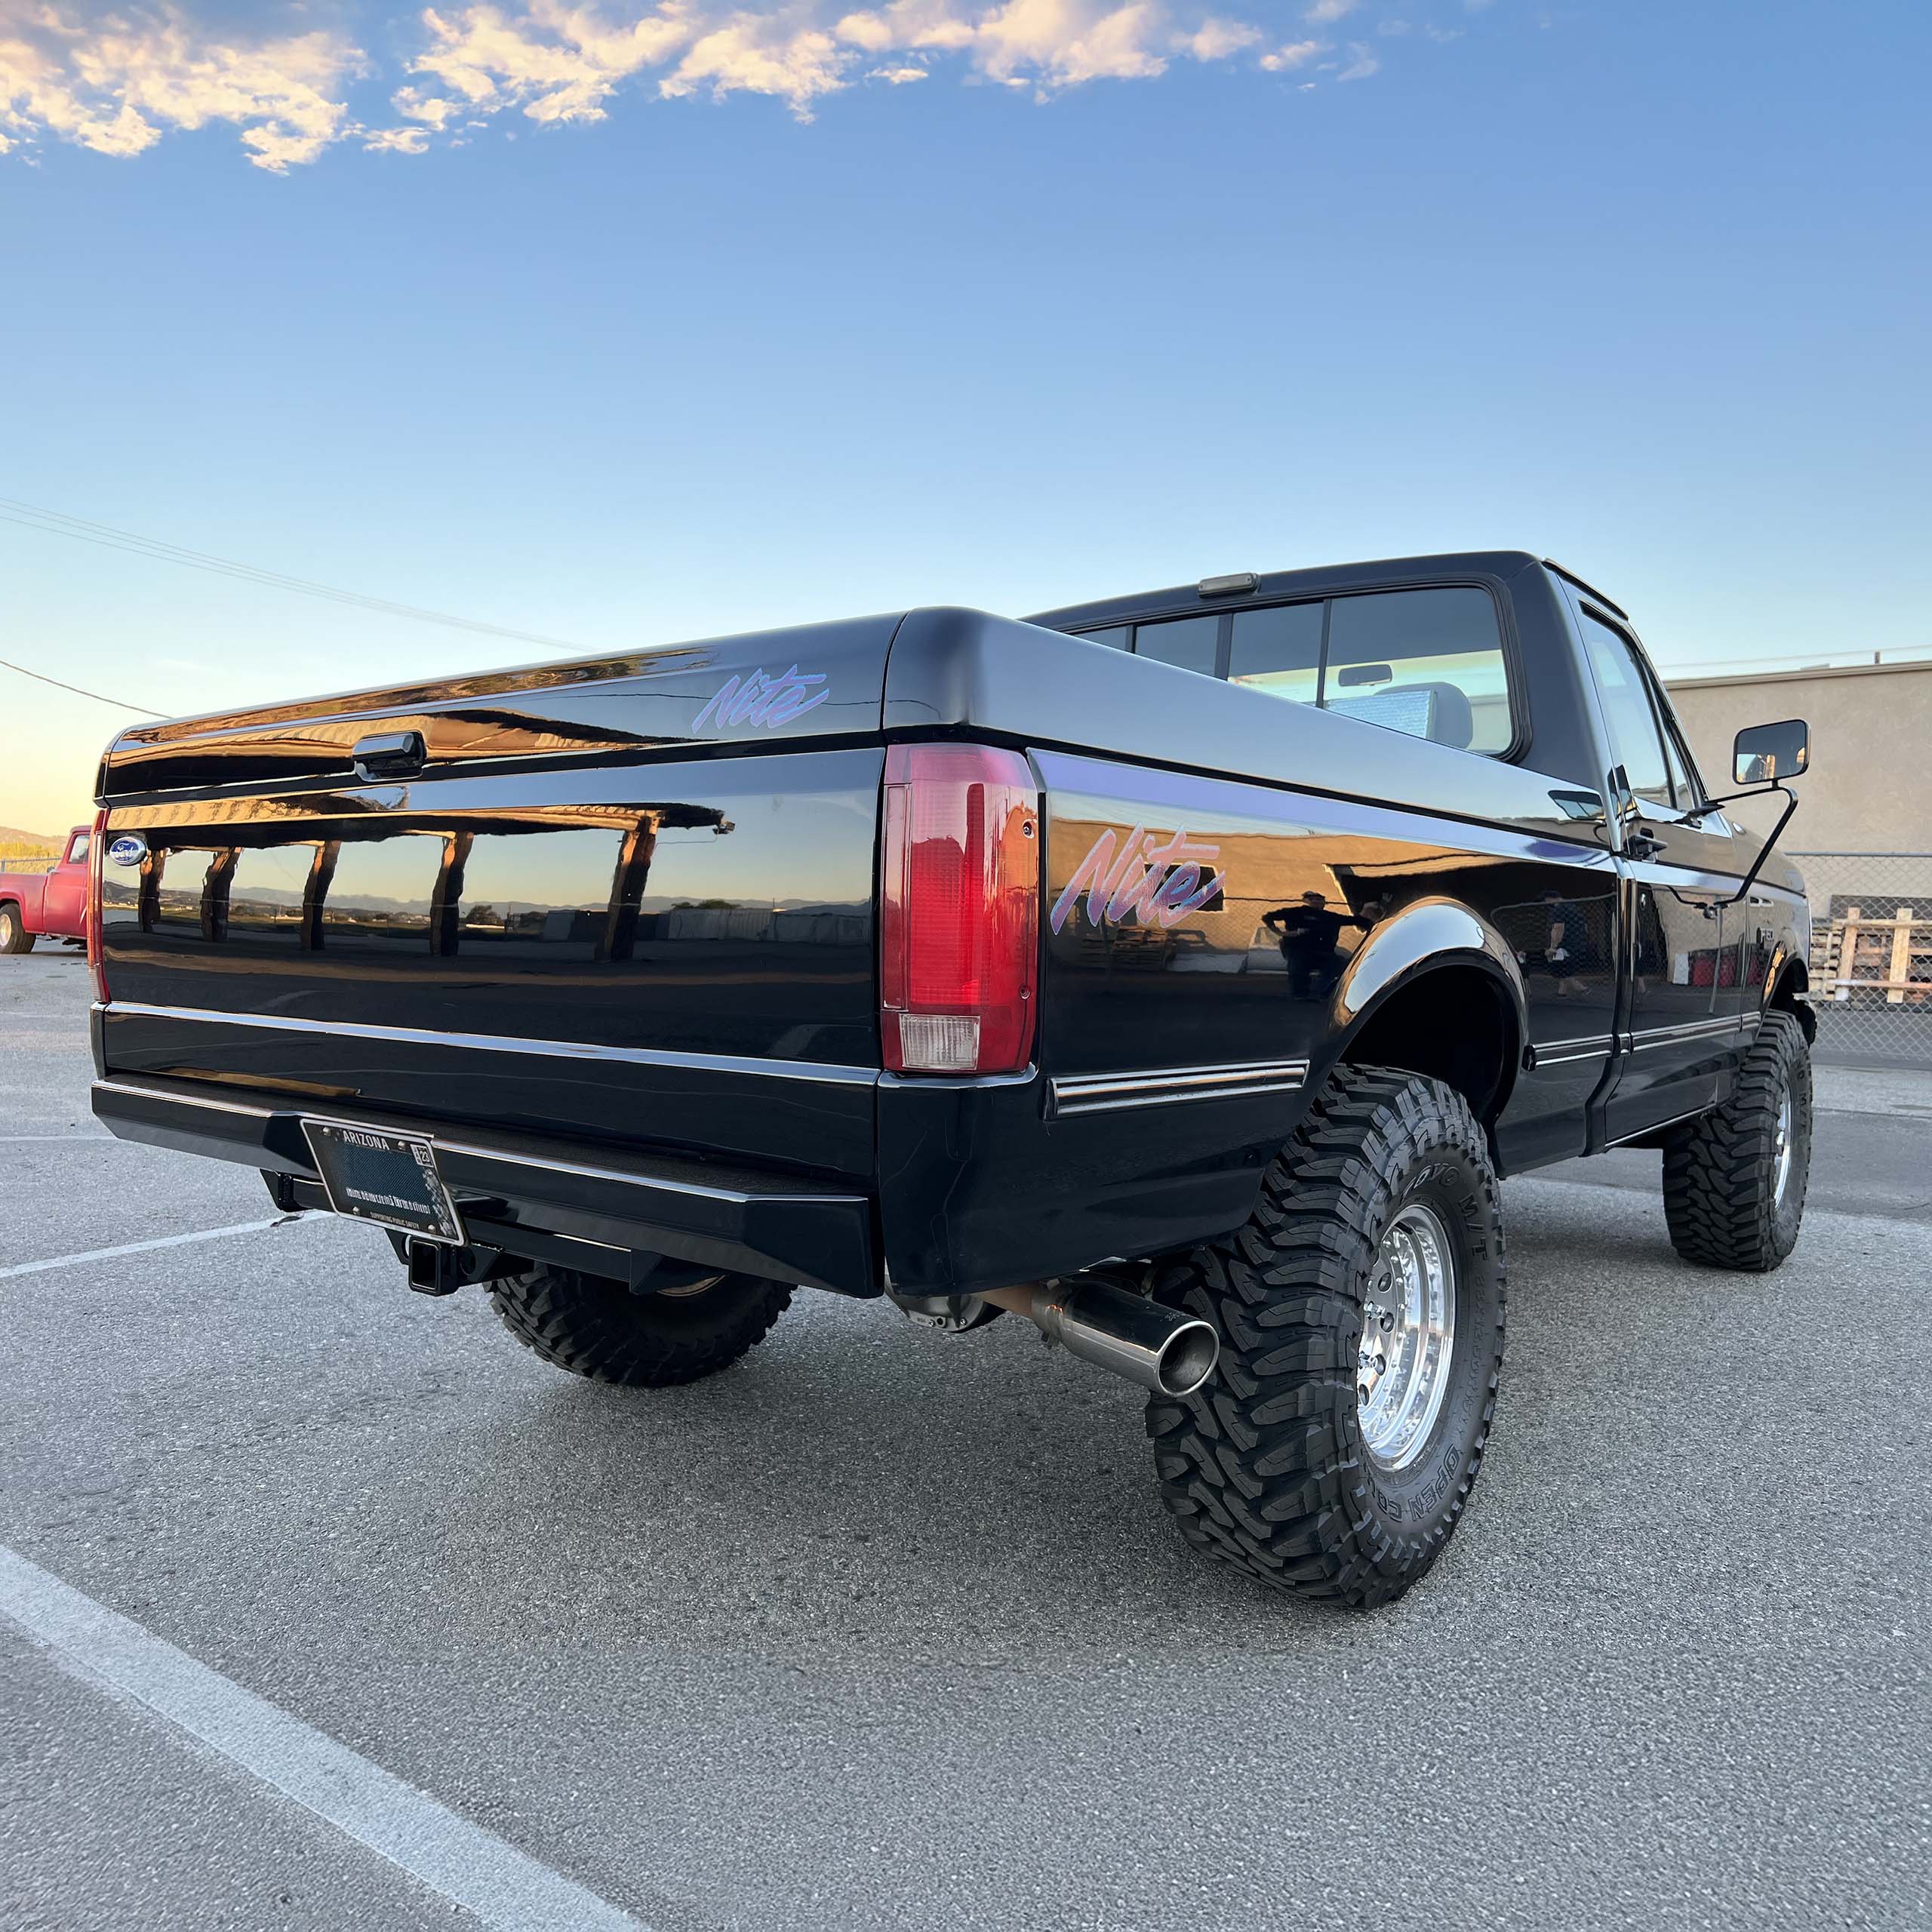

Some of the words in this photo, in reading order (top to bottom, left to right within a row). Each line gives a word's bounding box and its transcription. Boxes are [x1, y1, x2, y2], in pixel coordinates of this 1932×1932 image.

[691, 664, 829, 734] Nite
[1050, 821, 1226, 935] Nite
[342, 1130, 390, 1151] ARIZONA
[420, 1150, 430, 1162] 23
[1407, 1443, 1460, 1521] OPEN
